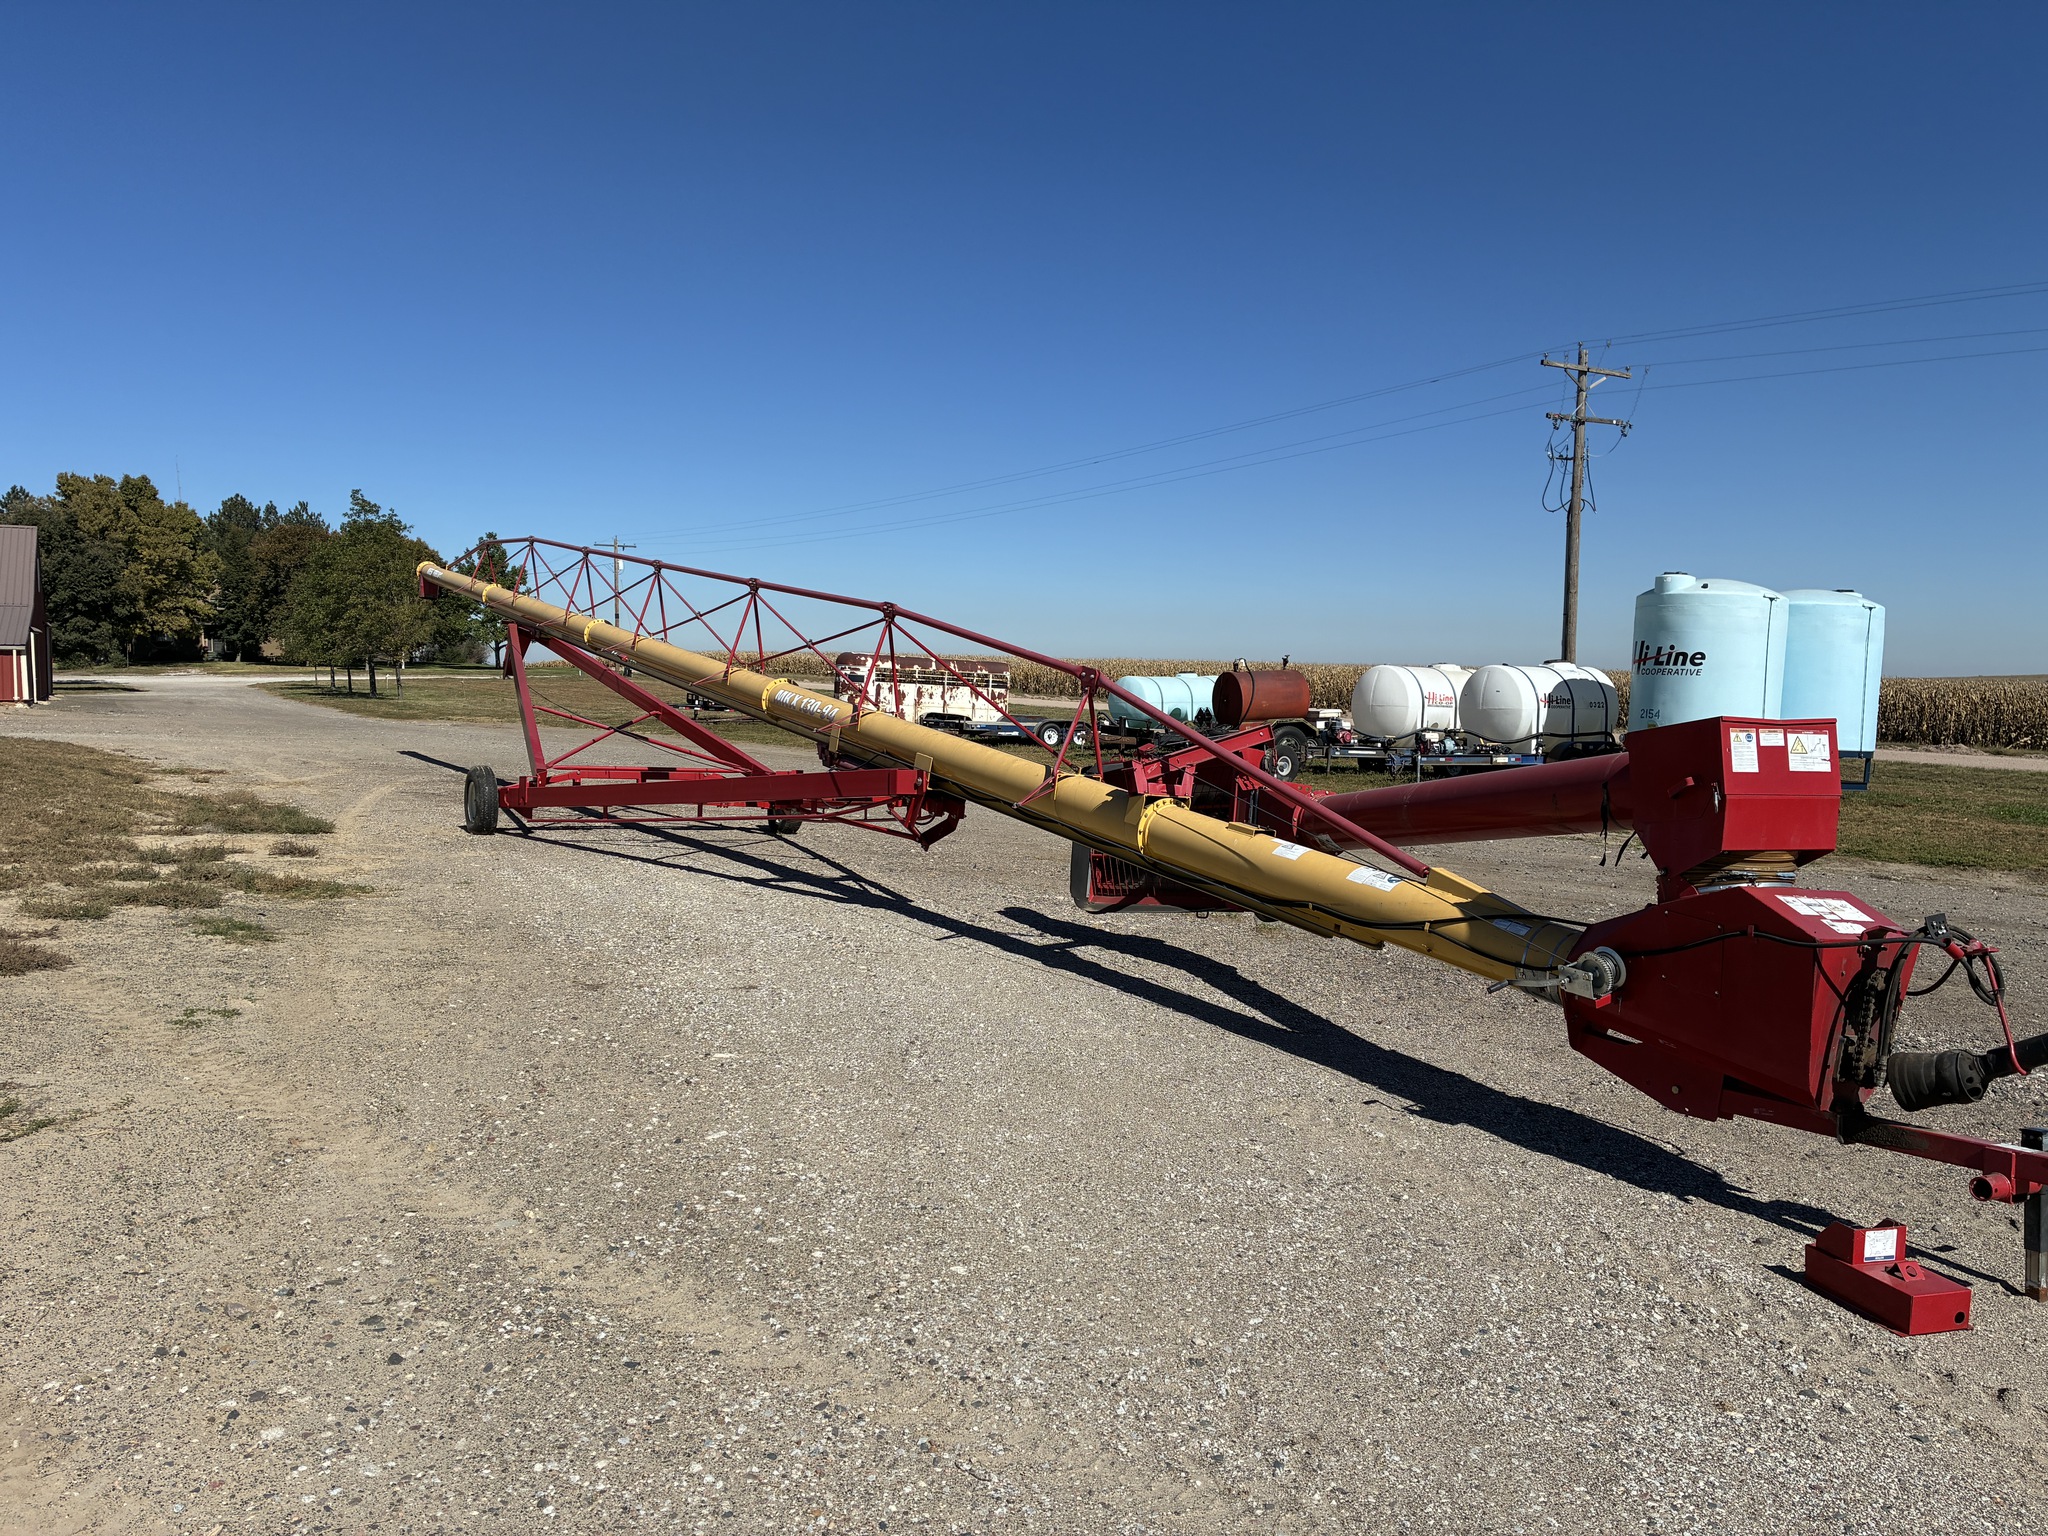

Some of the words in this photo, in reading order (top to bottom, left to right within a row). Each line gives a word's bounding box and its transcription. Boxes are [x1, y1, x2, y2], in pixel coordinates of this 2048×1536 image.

[1641, 667, 1703, 676] COOPERATIVE
[774, 689, 803, 709] MKX
[801, 697, 840, 721] 130-94
[1640, 708, 1660, 719] 2154
